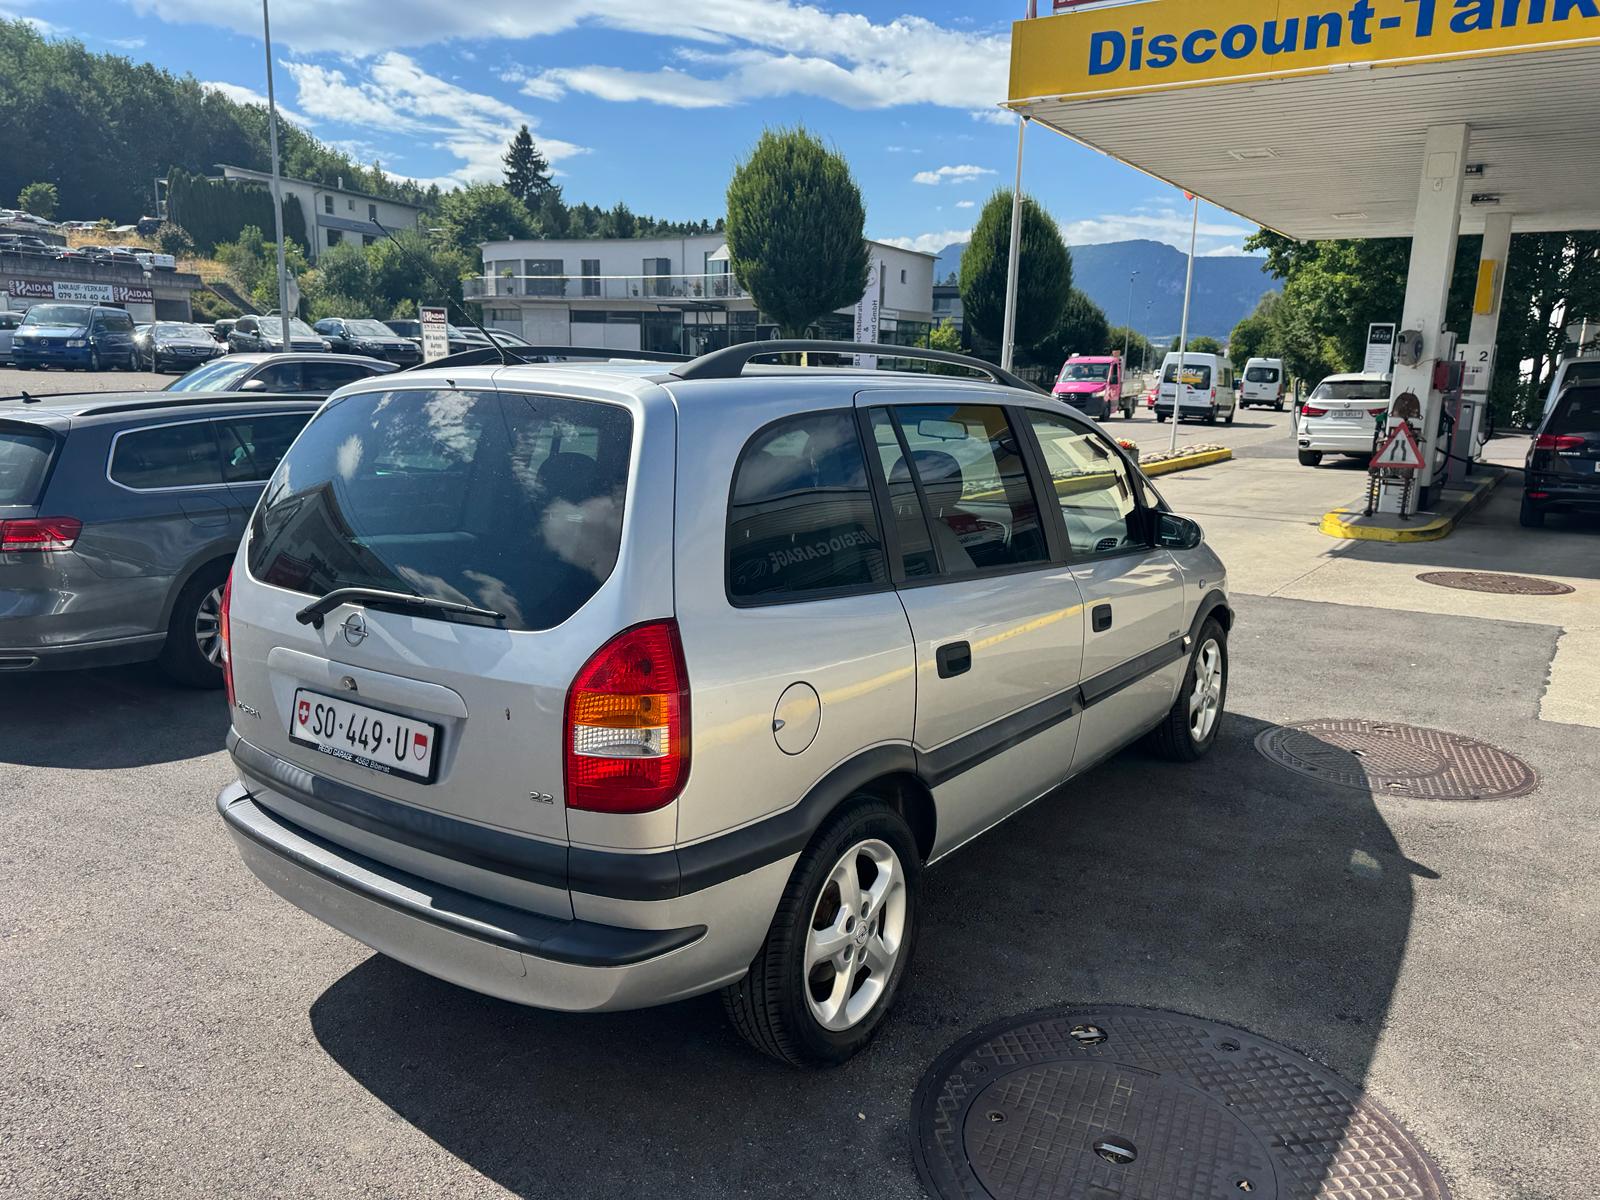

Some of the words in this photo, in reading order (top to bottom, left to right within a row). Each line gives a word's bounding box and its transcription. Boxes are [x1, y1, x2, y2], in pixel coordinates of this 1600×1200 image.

[1088, 0, 1600, 76] Discount-Tank
[8, 280, 16, 296] AUTO
[74, 292, 87, 300] 574
[89, 293, 99, 301] 40
[1458, 350, 1465, 361] 1
[1479, 350, 1488, 362] 2
[318, 743, 333, 755] REGIO
[332, 748, 353, 762] GARAGE
[354, 755, 370, 768] 4562
